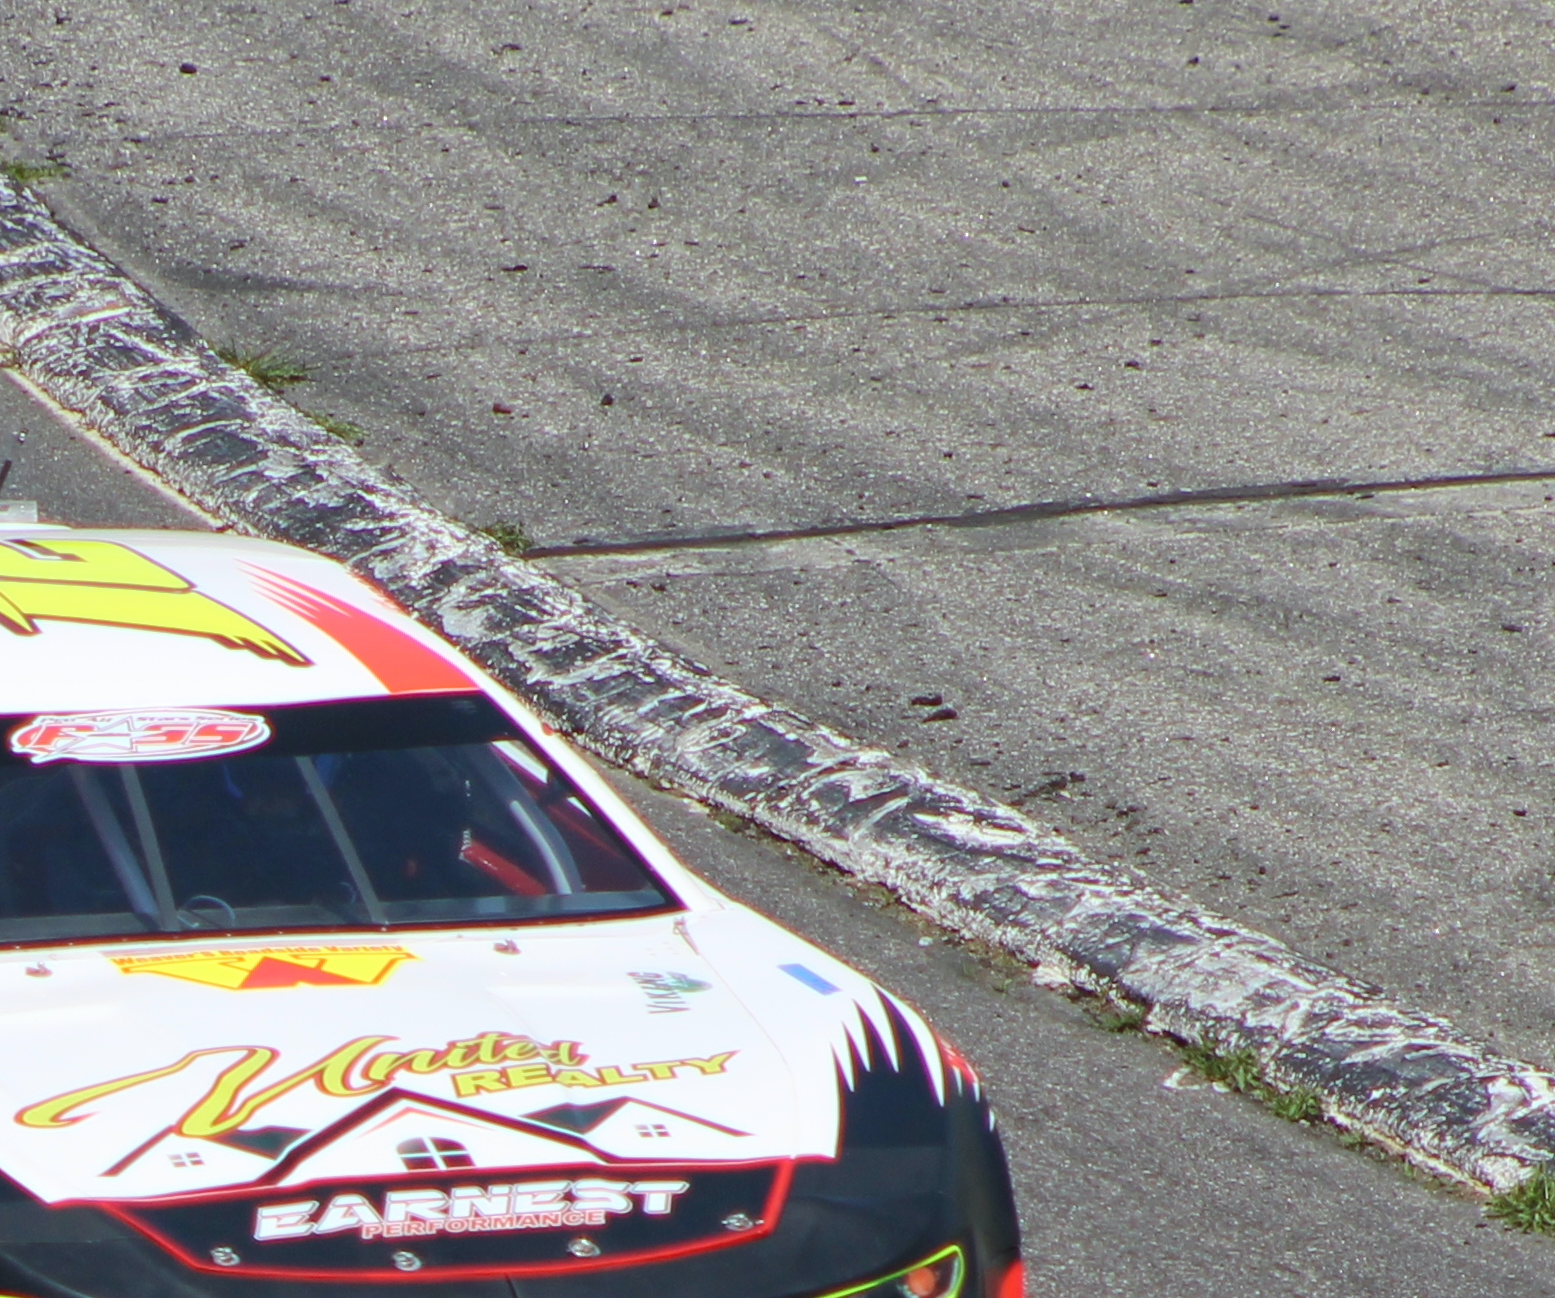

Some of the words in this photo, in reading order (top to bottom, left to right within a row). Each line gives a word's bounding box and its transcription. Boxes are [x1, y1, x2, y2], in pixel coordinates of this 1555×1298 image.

[13, 1031, 590, 1137] United
[452, 1050, 739, 1100] REALTY
[254, 1178, 689, 1240] EARNEST
[361, 1209, 607, 1240] PERFORMANCE
